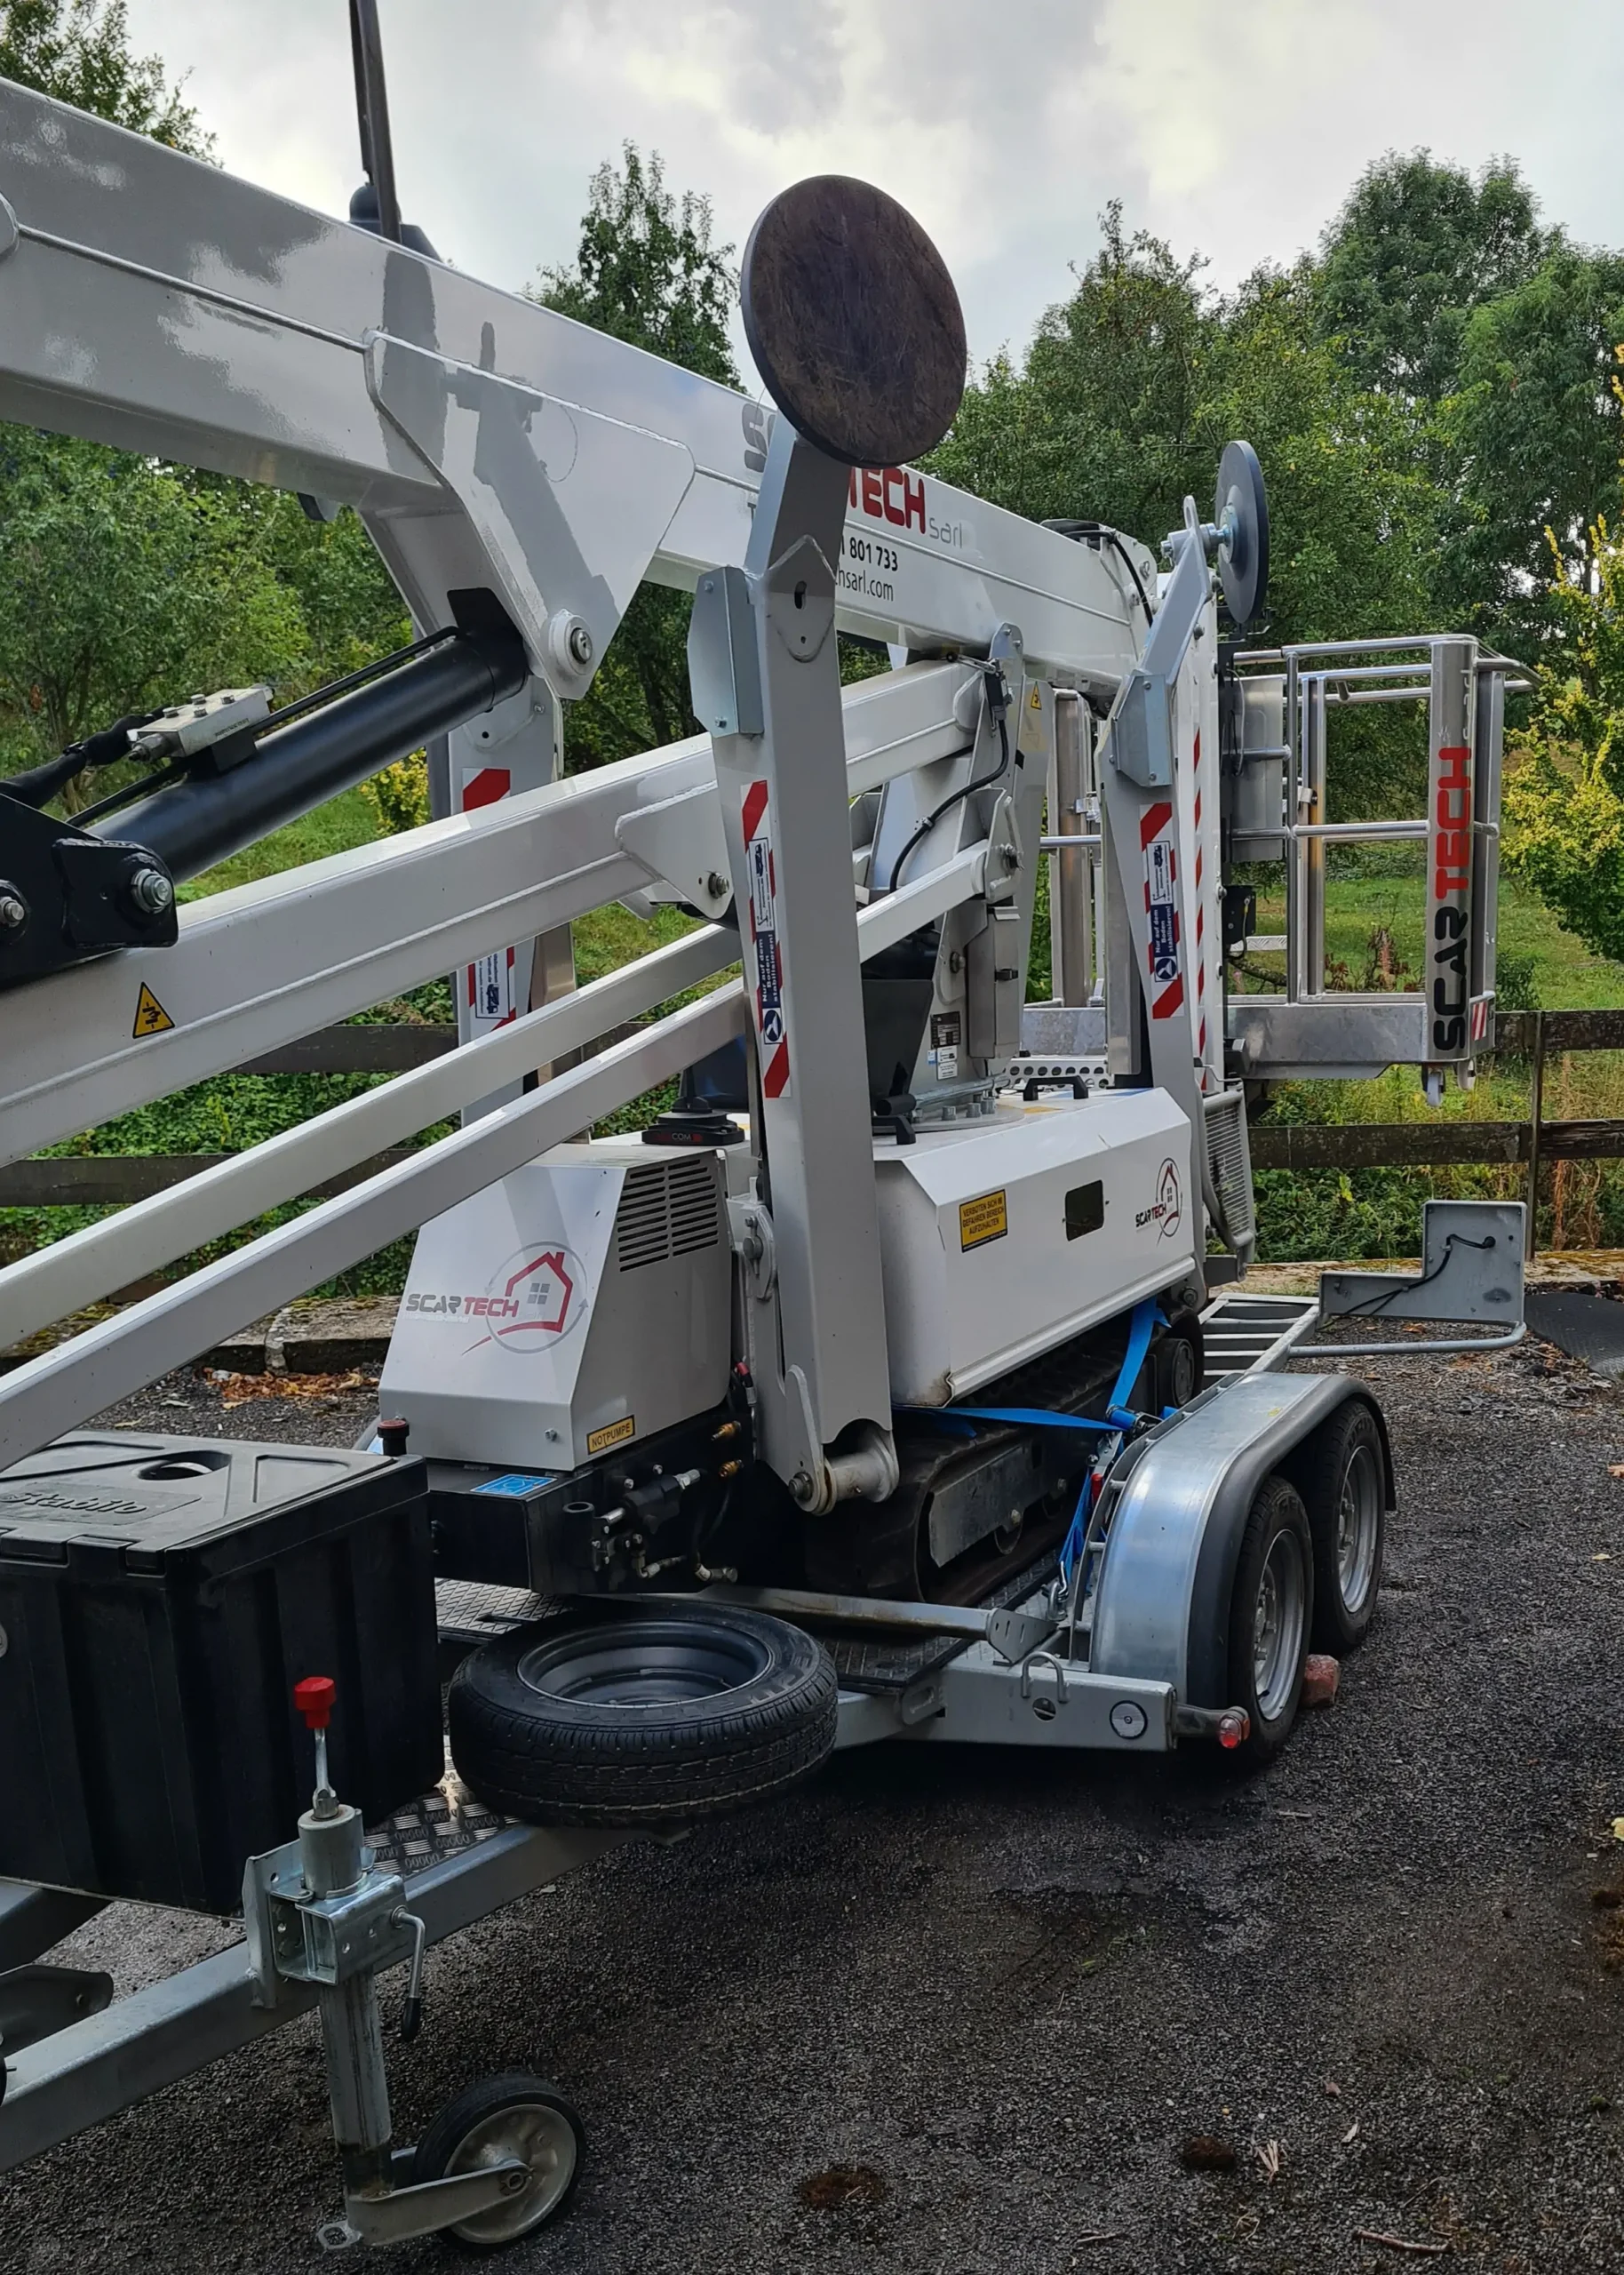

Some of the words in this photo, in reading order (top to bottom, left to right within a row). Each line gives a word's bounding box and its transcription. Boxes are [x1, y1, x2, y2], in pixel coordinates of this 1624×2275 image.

[928, 517, 963, 549] sarl
[849, 537, 872, 564] 801
[875, 545, 899, 571] 733
[591, 1423, 632, 1449] NOTPUMPE
